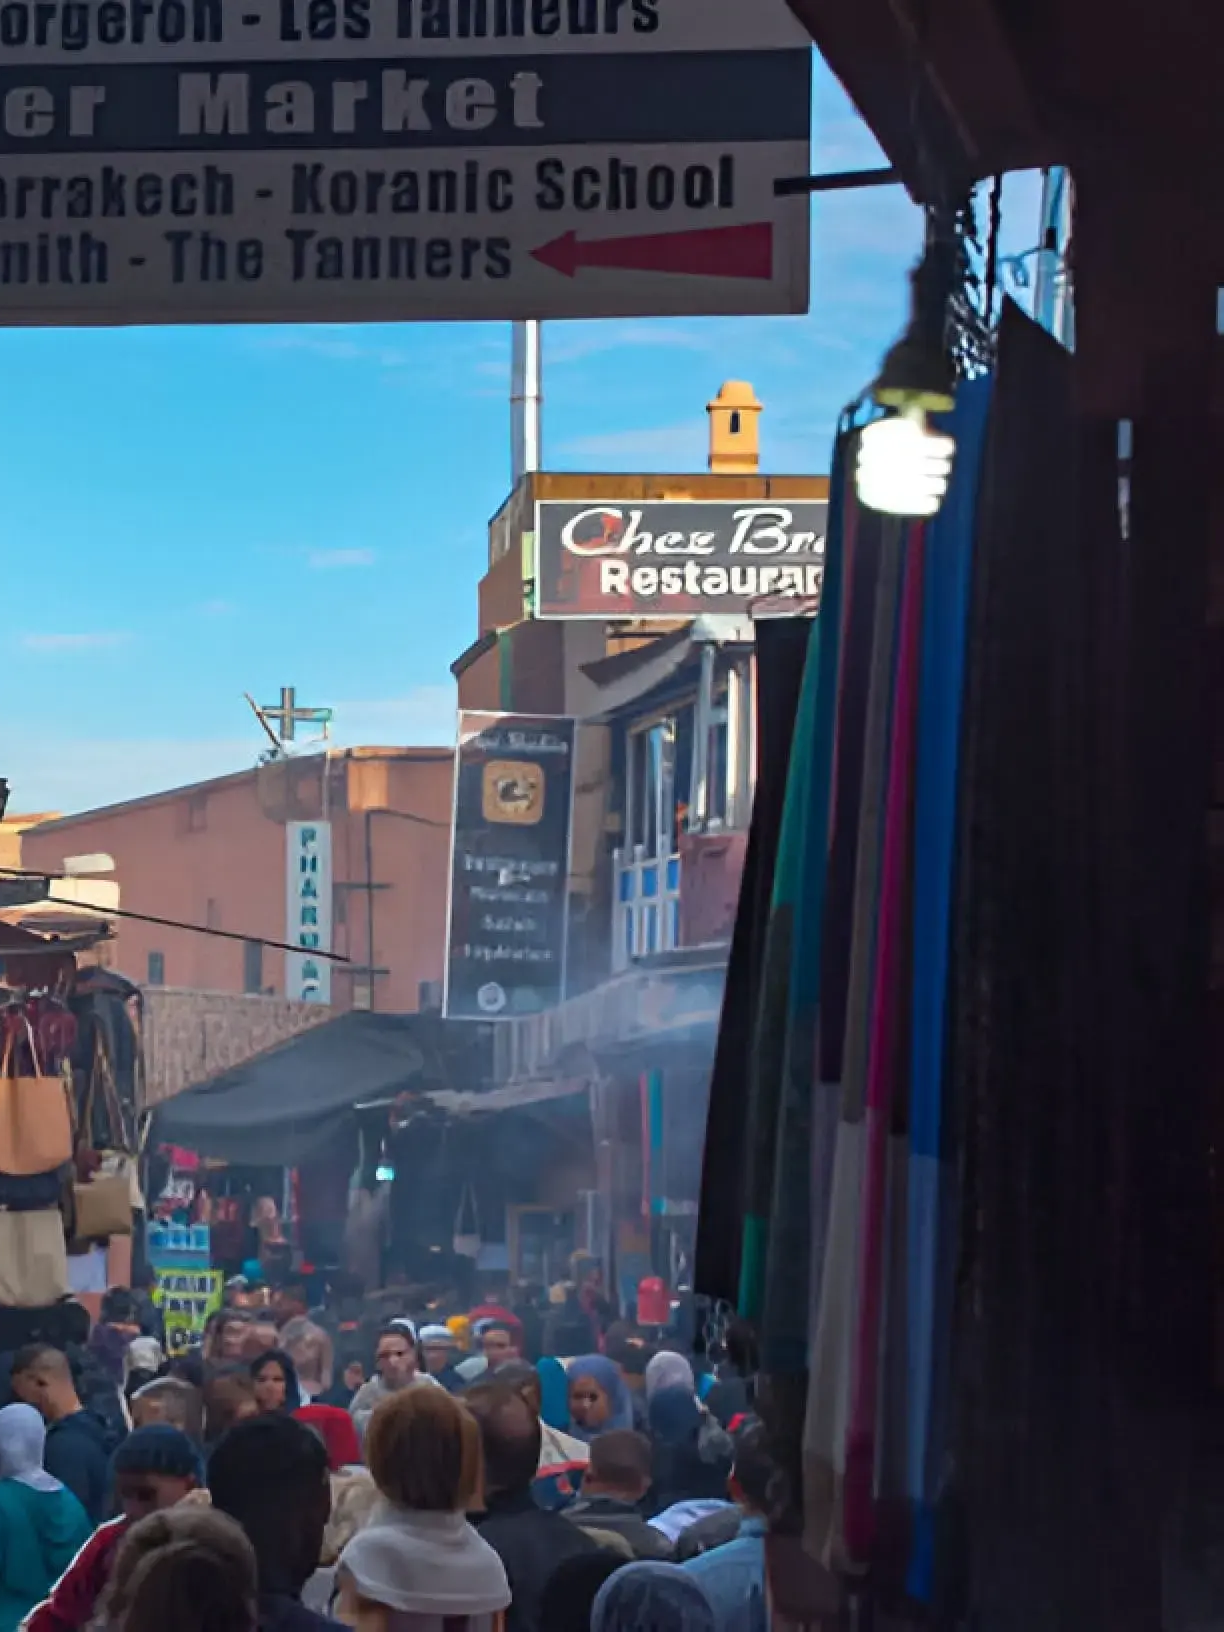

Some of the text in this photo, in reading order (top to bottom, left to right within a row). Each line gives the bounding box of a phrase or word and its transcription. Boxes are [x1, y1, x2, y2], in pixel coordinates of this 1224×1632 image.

[280, 0, 370, 41] Les
[178, 69, 545, 136] Market
[292, 160, 514, 215] Koranic
[536, 155, 734, 211] School
[164, 230, 263, 283] The
[284, 228, 511, 282] Tanners
[561, 508, 715, 555] Chez
